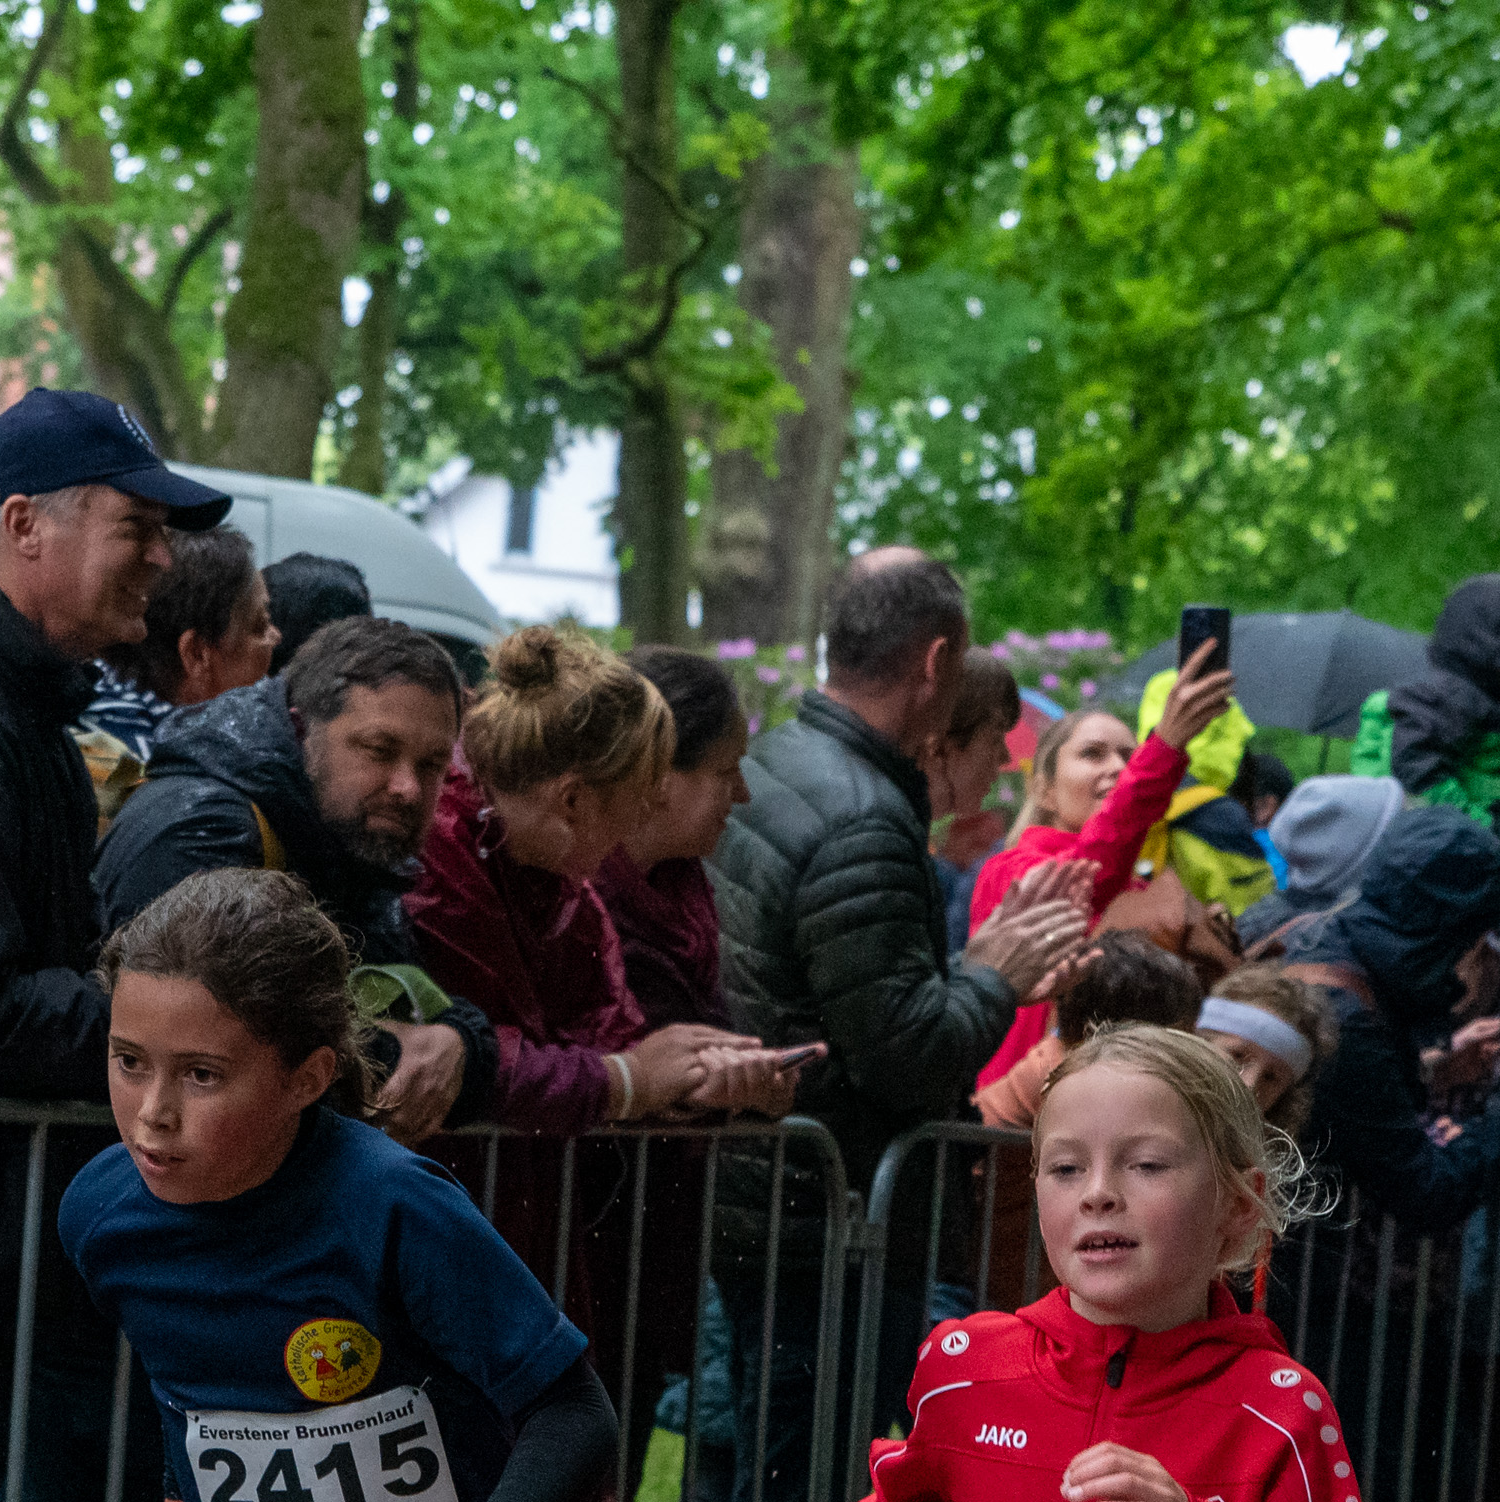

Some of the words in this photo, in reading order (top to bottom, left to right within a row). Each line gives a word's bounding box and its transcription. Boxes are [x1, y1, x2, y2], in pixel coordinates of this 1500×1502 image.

[199, 1424, 291, 1442] Everstener
[295, 1400, 416, 1441] Brunnenlauf
[974, 1423, 1028, 1450] JAKO
